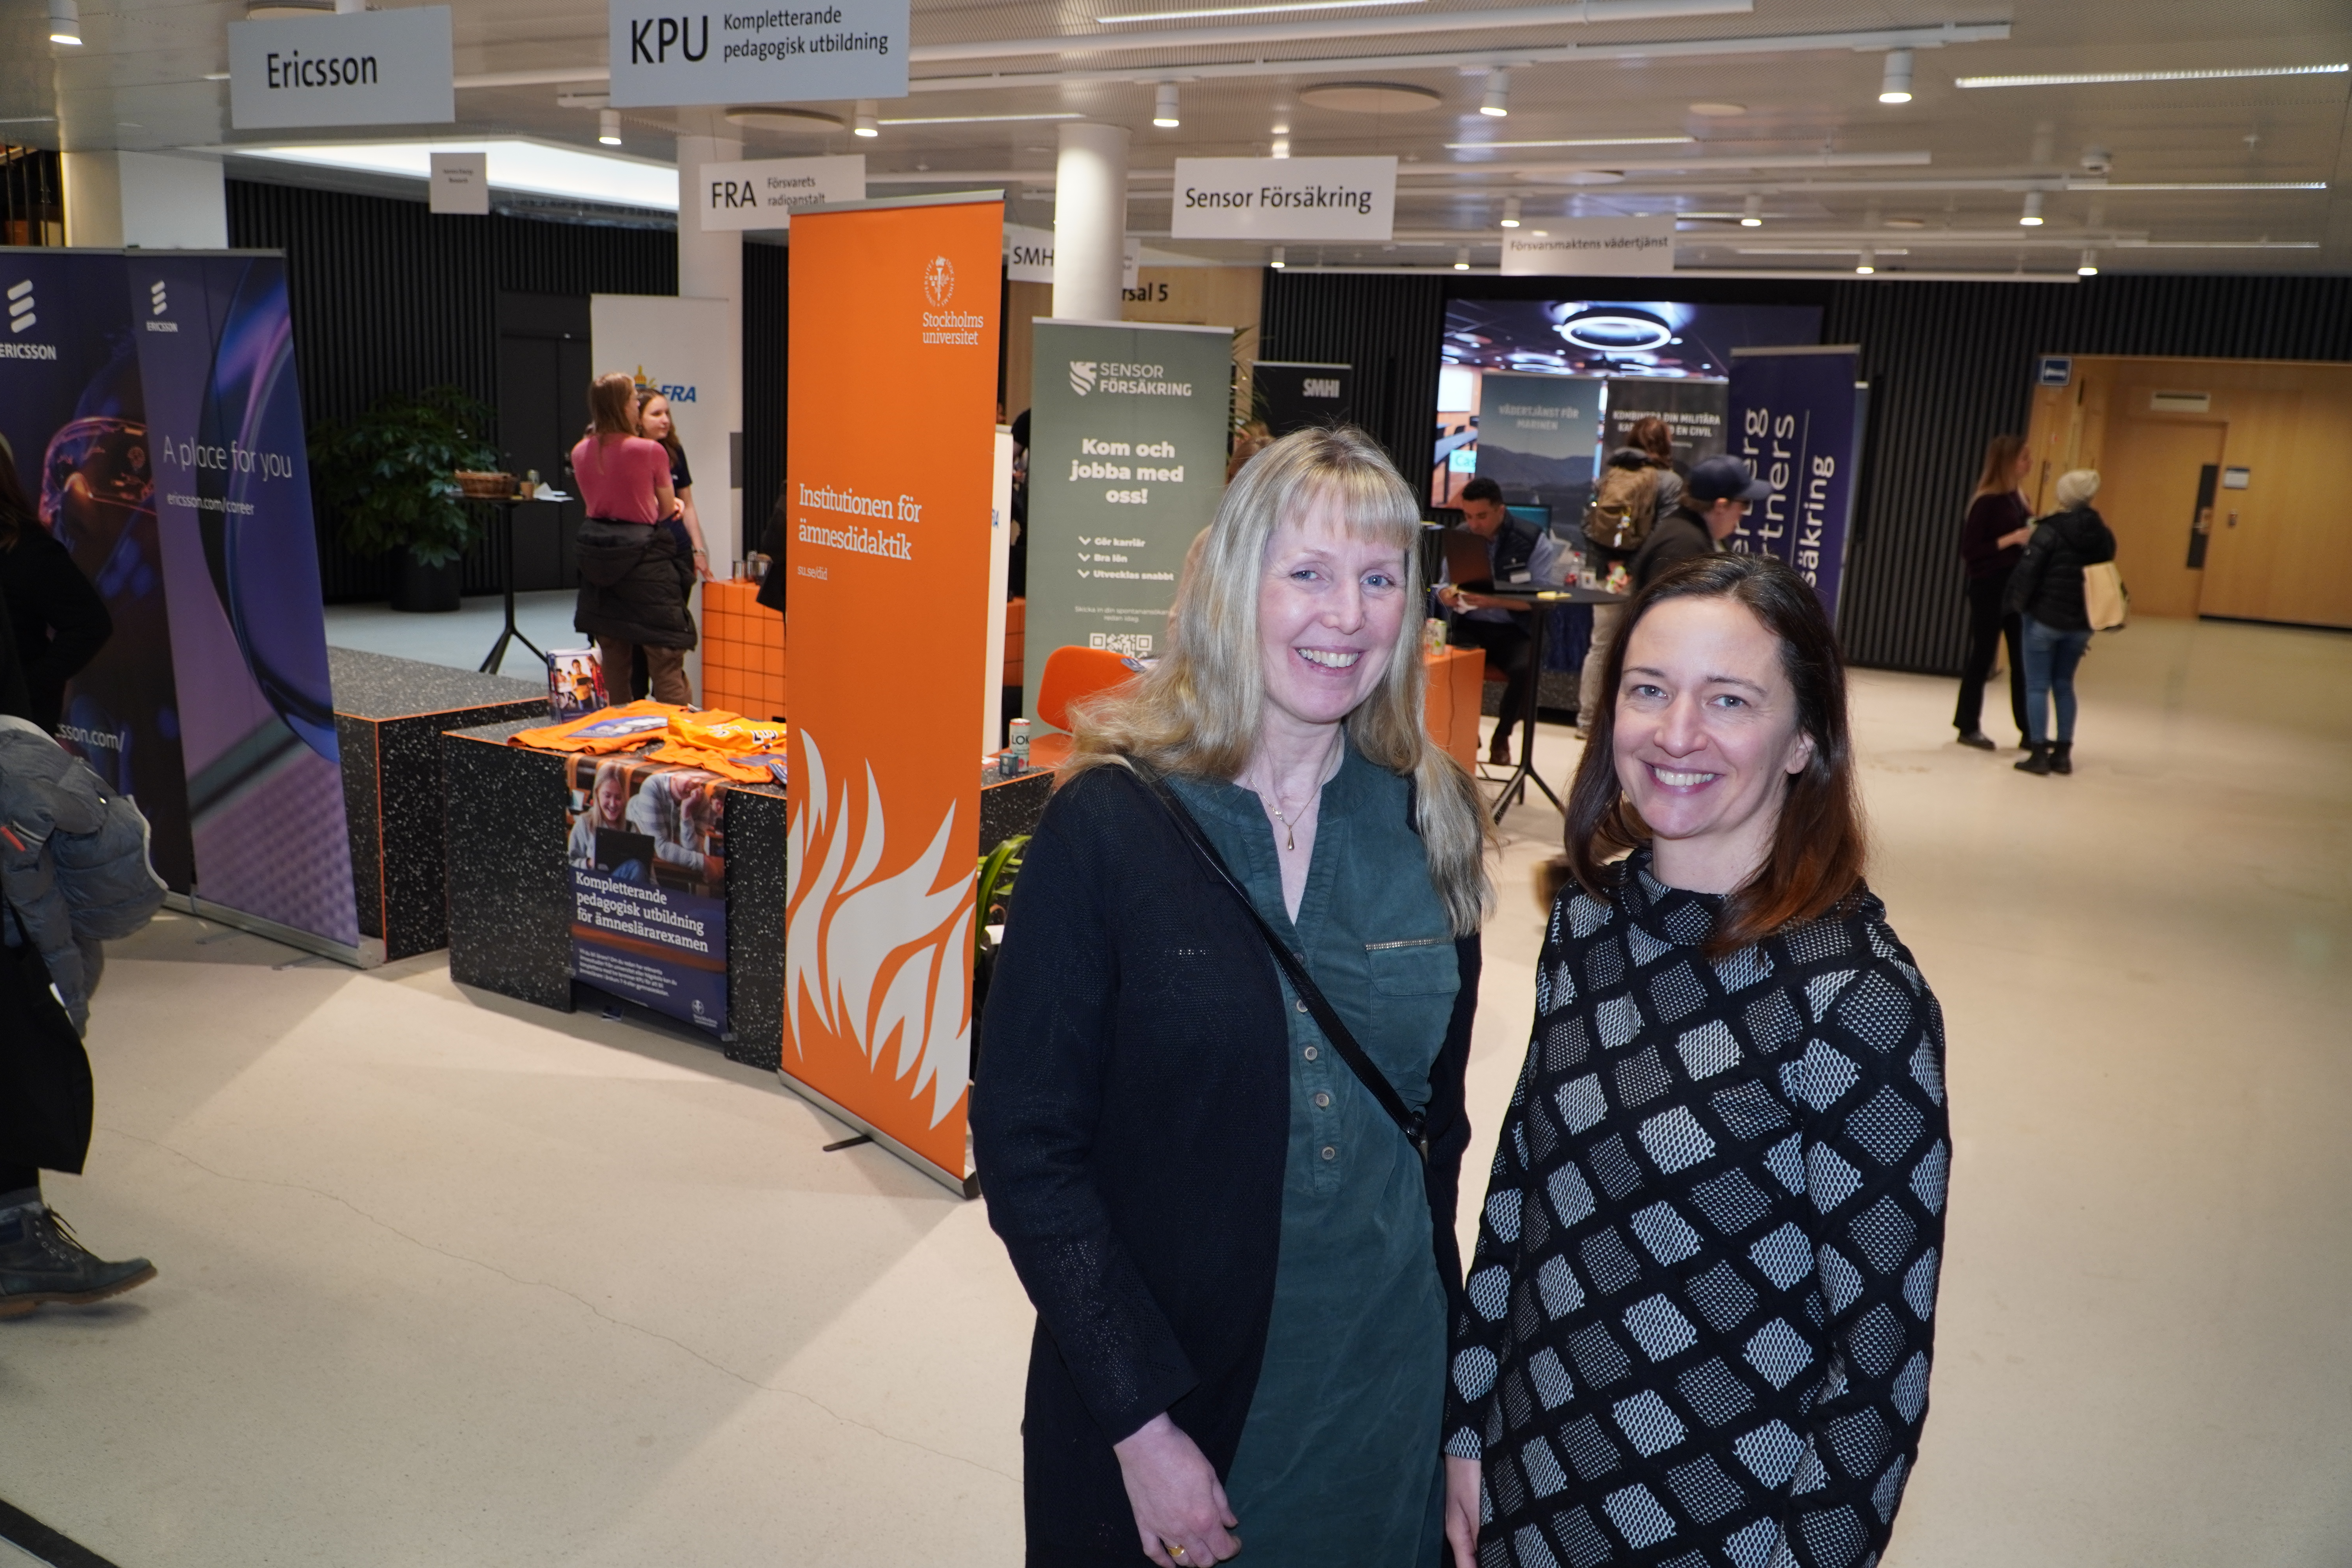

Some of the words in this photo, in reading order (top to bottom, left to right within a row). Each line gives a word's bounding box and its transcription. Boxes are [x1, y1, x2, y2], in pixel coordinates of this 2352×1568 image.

[724, 6, 841, 34] Kompletterande
[632, 16, 708, 64] KPU
[724, 35, 805, 62] pedagogisk
[810, 33, 888, 54] utbildning
[267, 49, 377, 89] Ericsson
[767, 177, 816, 189] Försvarets
[712, 180, 757, 208] FRA
[767, 193, 825, 206] radioanstalt
[1185, 187, 1252, 209] Sensor
[1261, 186, 1372, 214] Försäkring
[1511, 238, 1601, 251] Försvarsmaktens
[1605, 236, 1668, 251] vädertjänst
[1158, 284, 1168, 302] 5
[146, 321, 178, 332] ERICSSON
[923, 311, 984, 328] Stockholms
[923, 327, 978, 345] universitet
[0, 342, 57, 360] ERICSSON
[1100, 363, 1163, 378] SENSOR
[662, 386, 696, 402] FRA
[1100, 379, 1192, 397] FÖRSÄKRING
[1302, 378, 1340, 398] SMHI
[1082, 439, 1130, 456] Kom
[1135, 441, 1175, 458] och
[164, 436, 178, 464] A
[180, 437, 227, 471] place
[231, 441, 256, 473] for
[260, 450, 292, 481] you
[1069, 460, 1131, 481] jobba
[1137, 465, 1184, 482] med
[799, 483, 893, 519] Institutionen
[898, 495, 922, 523] för
[1105, 488, 1148, 504] oss!
[799, 518, 911, 560] ämnesdidaktik
[1094, 537, 1112, 546] Gör
[1113, 537, 1145, 547] karriär
[1094, 554, 1111, 562] Bra
[1112, 554, 1128, 563] lön
[1093, 570, 1140, 579] Utvecklas
[1141, 572, 1174, 581] snabbt
[576, 871, 667, 904] Kompletterande
[577, 892, 641, 916] pedagogisk
[643, 907, 704, 936] utbildning
[577, 907, 592, 922] för
[595, 912, 709, 952] ämneslärarexamen
